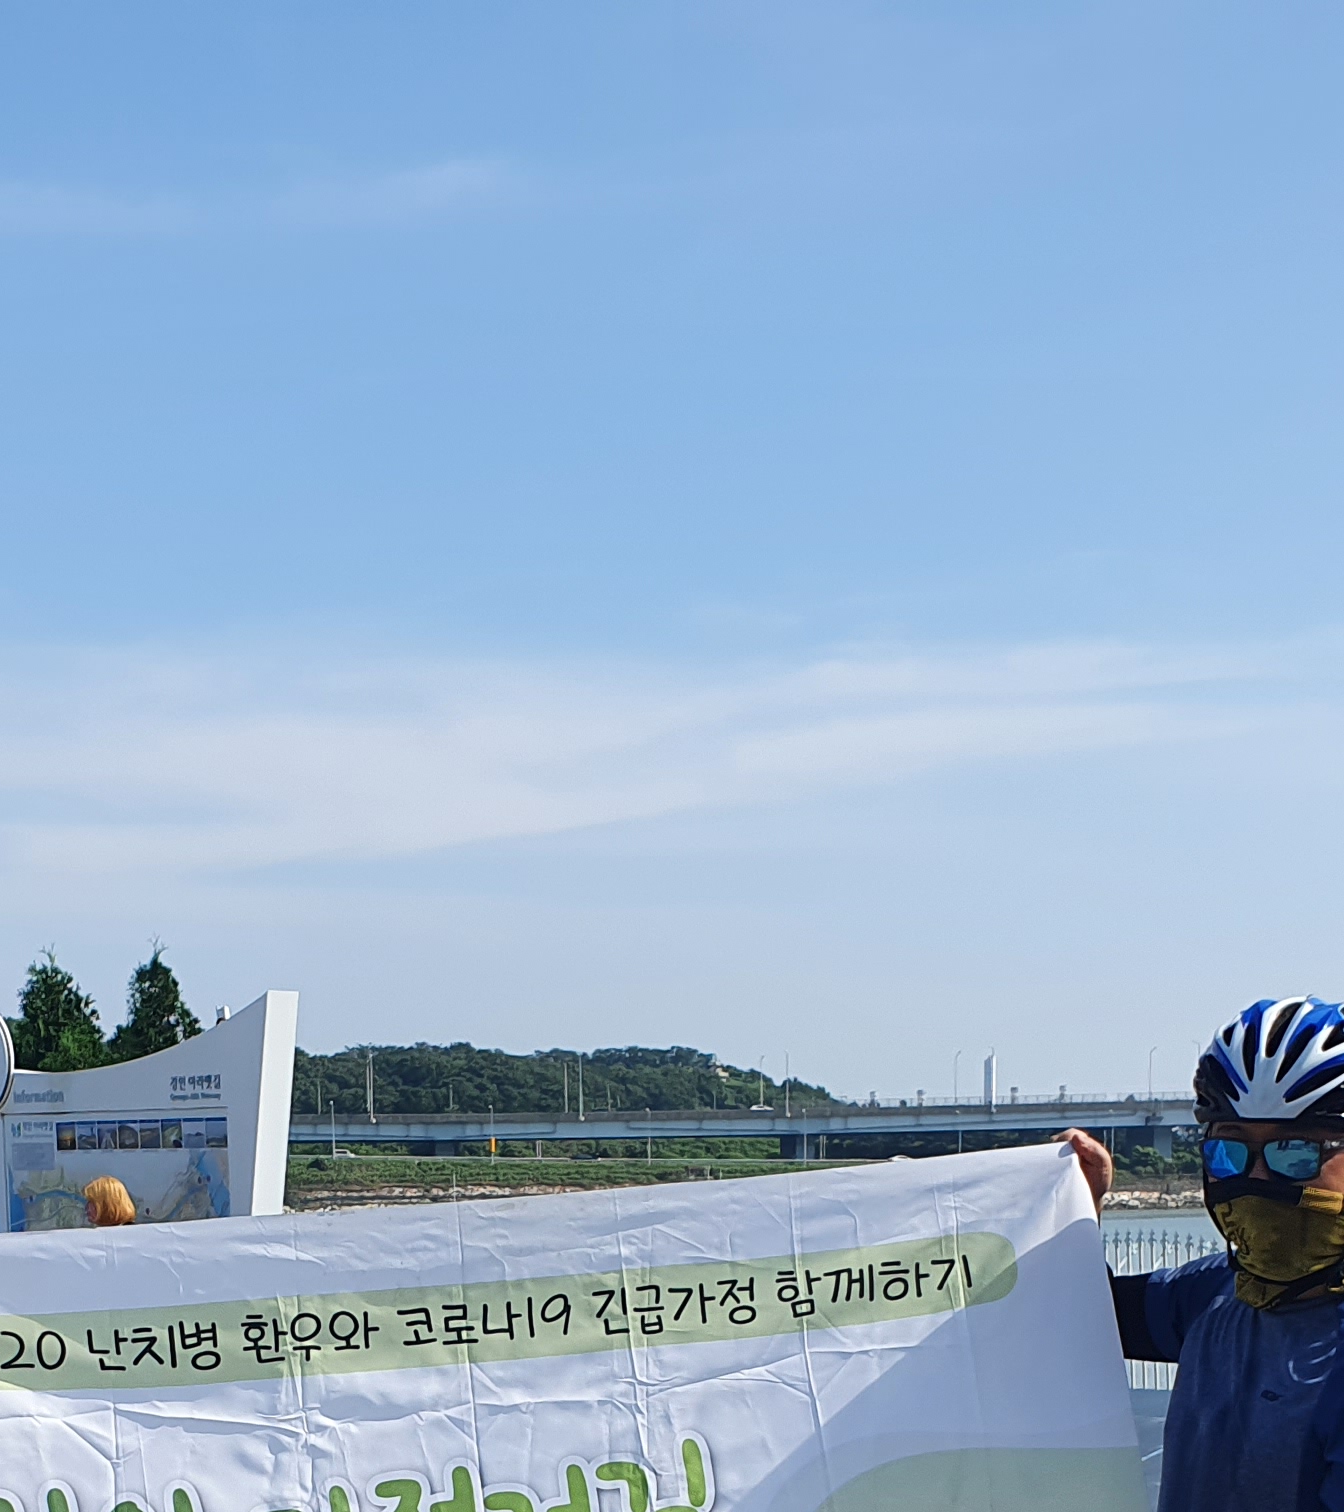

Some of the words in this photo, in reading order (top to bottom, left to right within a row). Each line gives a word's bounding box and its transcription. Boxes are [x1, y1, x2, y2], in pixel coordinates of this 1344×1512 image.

[85, 1319, 222, 1372] 난치병
[240, 1310, 380, 1364] 환우와
[402, 1293, 572, 1347] 코로나19
[591, 1276, 757, 1336] 긴급가정
[775, 1254, 973, 1320] 함께하기
